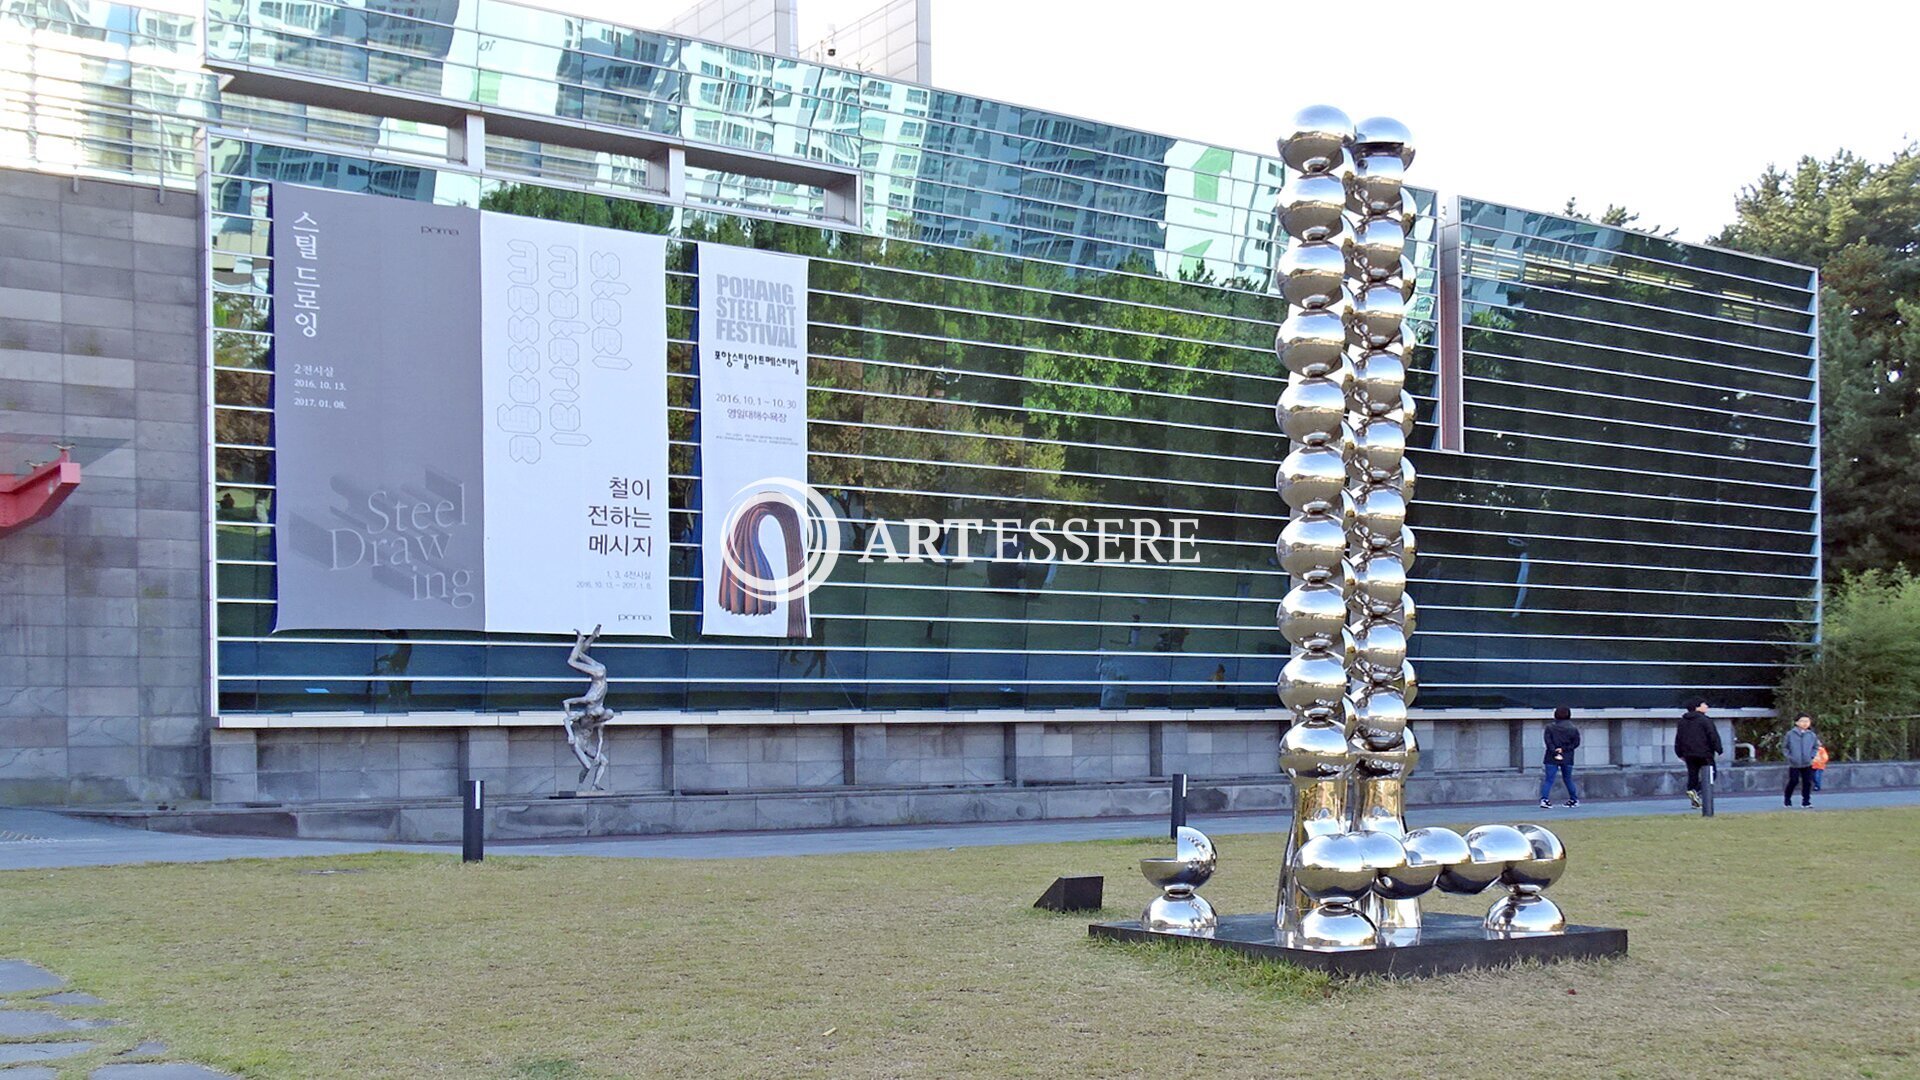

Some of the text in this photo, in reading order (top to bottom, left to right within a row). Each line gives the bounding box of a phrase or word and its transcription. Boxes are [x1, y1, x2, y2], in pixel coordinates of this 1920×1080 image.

[293, 211, 320, 338] 스틸 드로잉
[716, 273, 794, 305] POHANG
[716, 296, 796, 327] STEEL ART
[716, 318, 798, 349] FESTIVAL
[609, 476, 650, 501] 철이
[366, 483, 468, 534] Steel
[588, 505, 652, 529] 전하는
[329, 528, 453, 571] Draw
[589, 534, 652, 557] 메시지
[411, 565, 474, 609] ing
